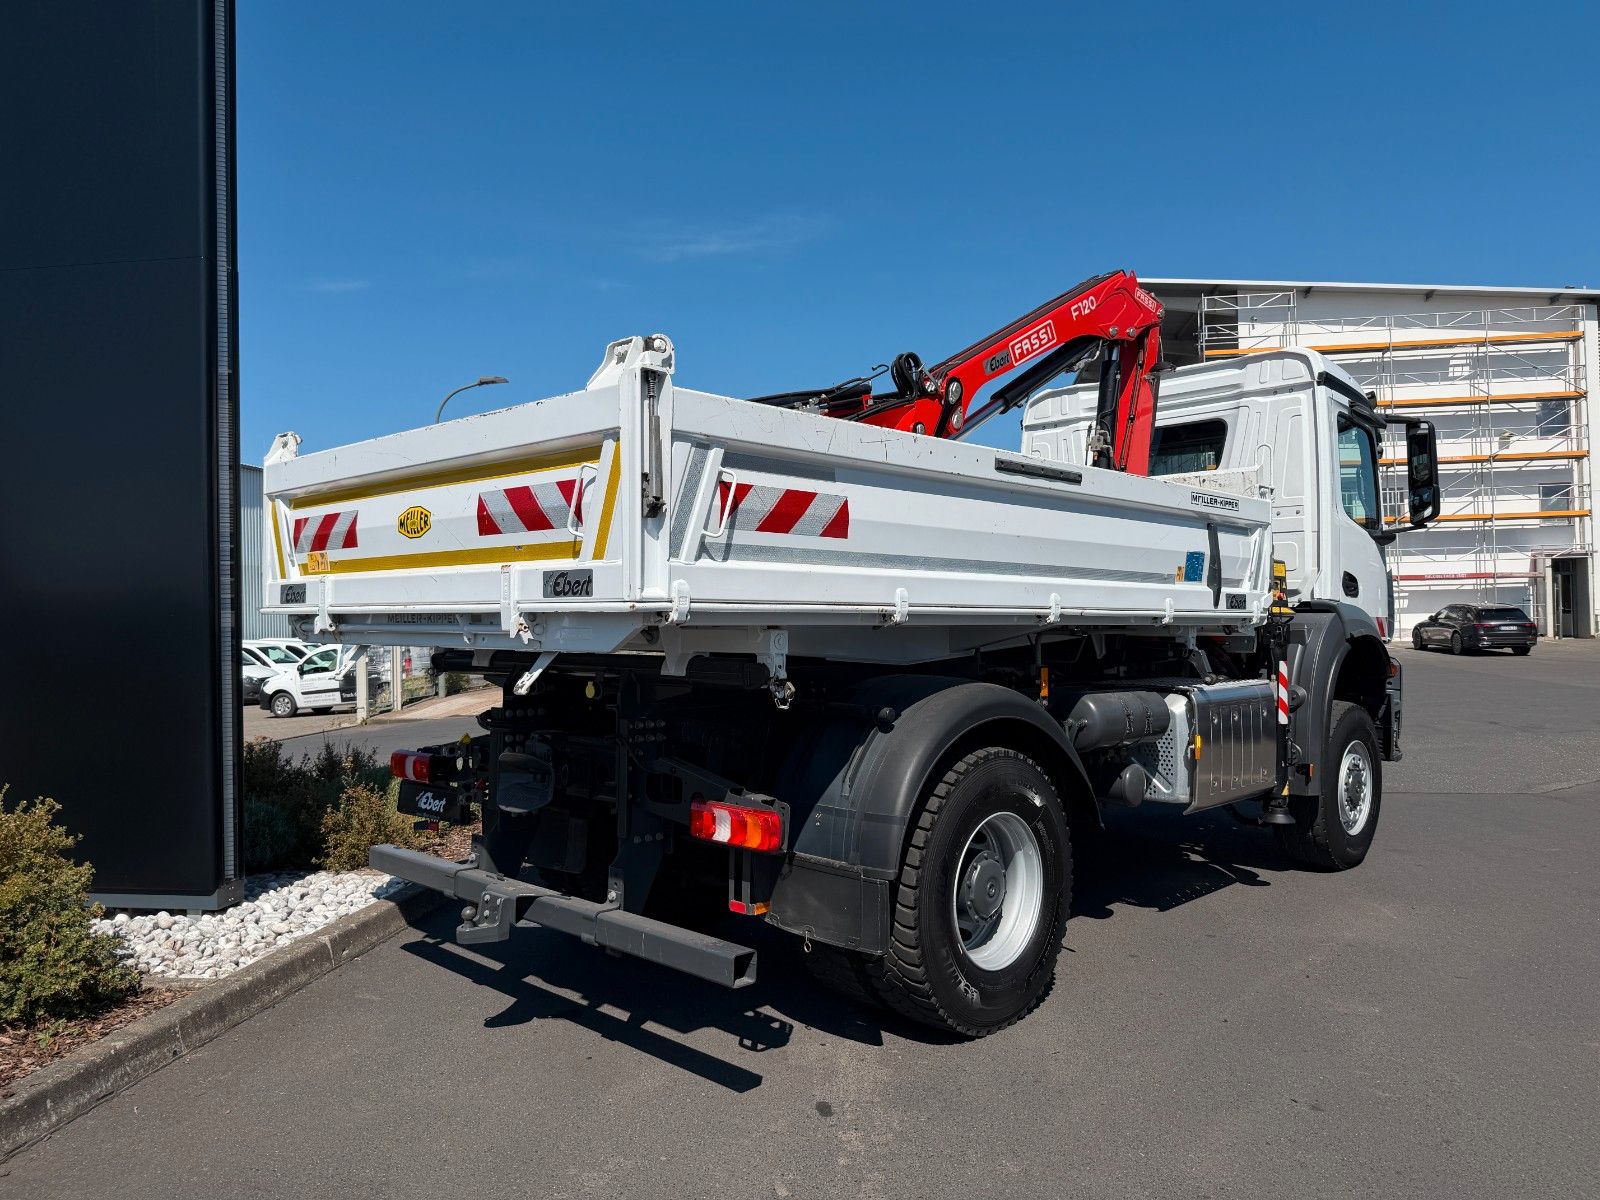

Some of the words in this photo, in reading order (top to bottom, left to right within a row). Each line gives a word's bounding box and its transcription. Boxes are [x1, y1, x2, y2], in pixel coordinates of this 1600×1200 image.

[1071, 296, 1097, 321] F120
[1136, 290, 1155, 310] FASSI
[1014, 326, 1053, 360] FASSI
[989, 352, 1010, 372] Ebert
[399, 509, 430, 535] MEILLER
[553, 571, 593, 597] Ebert
[418, 791, 447, 812] Ebert
